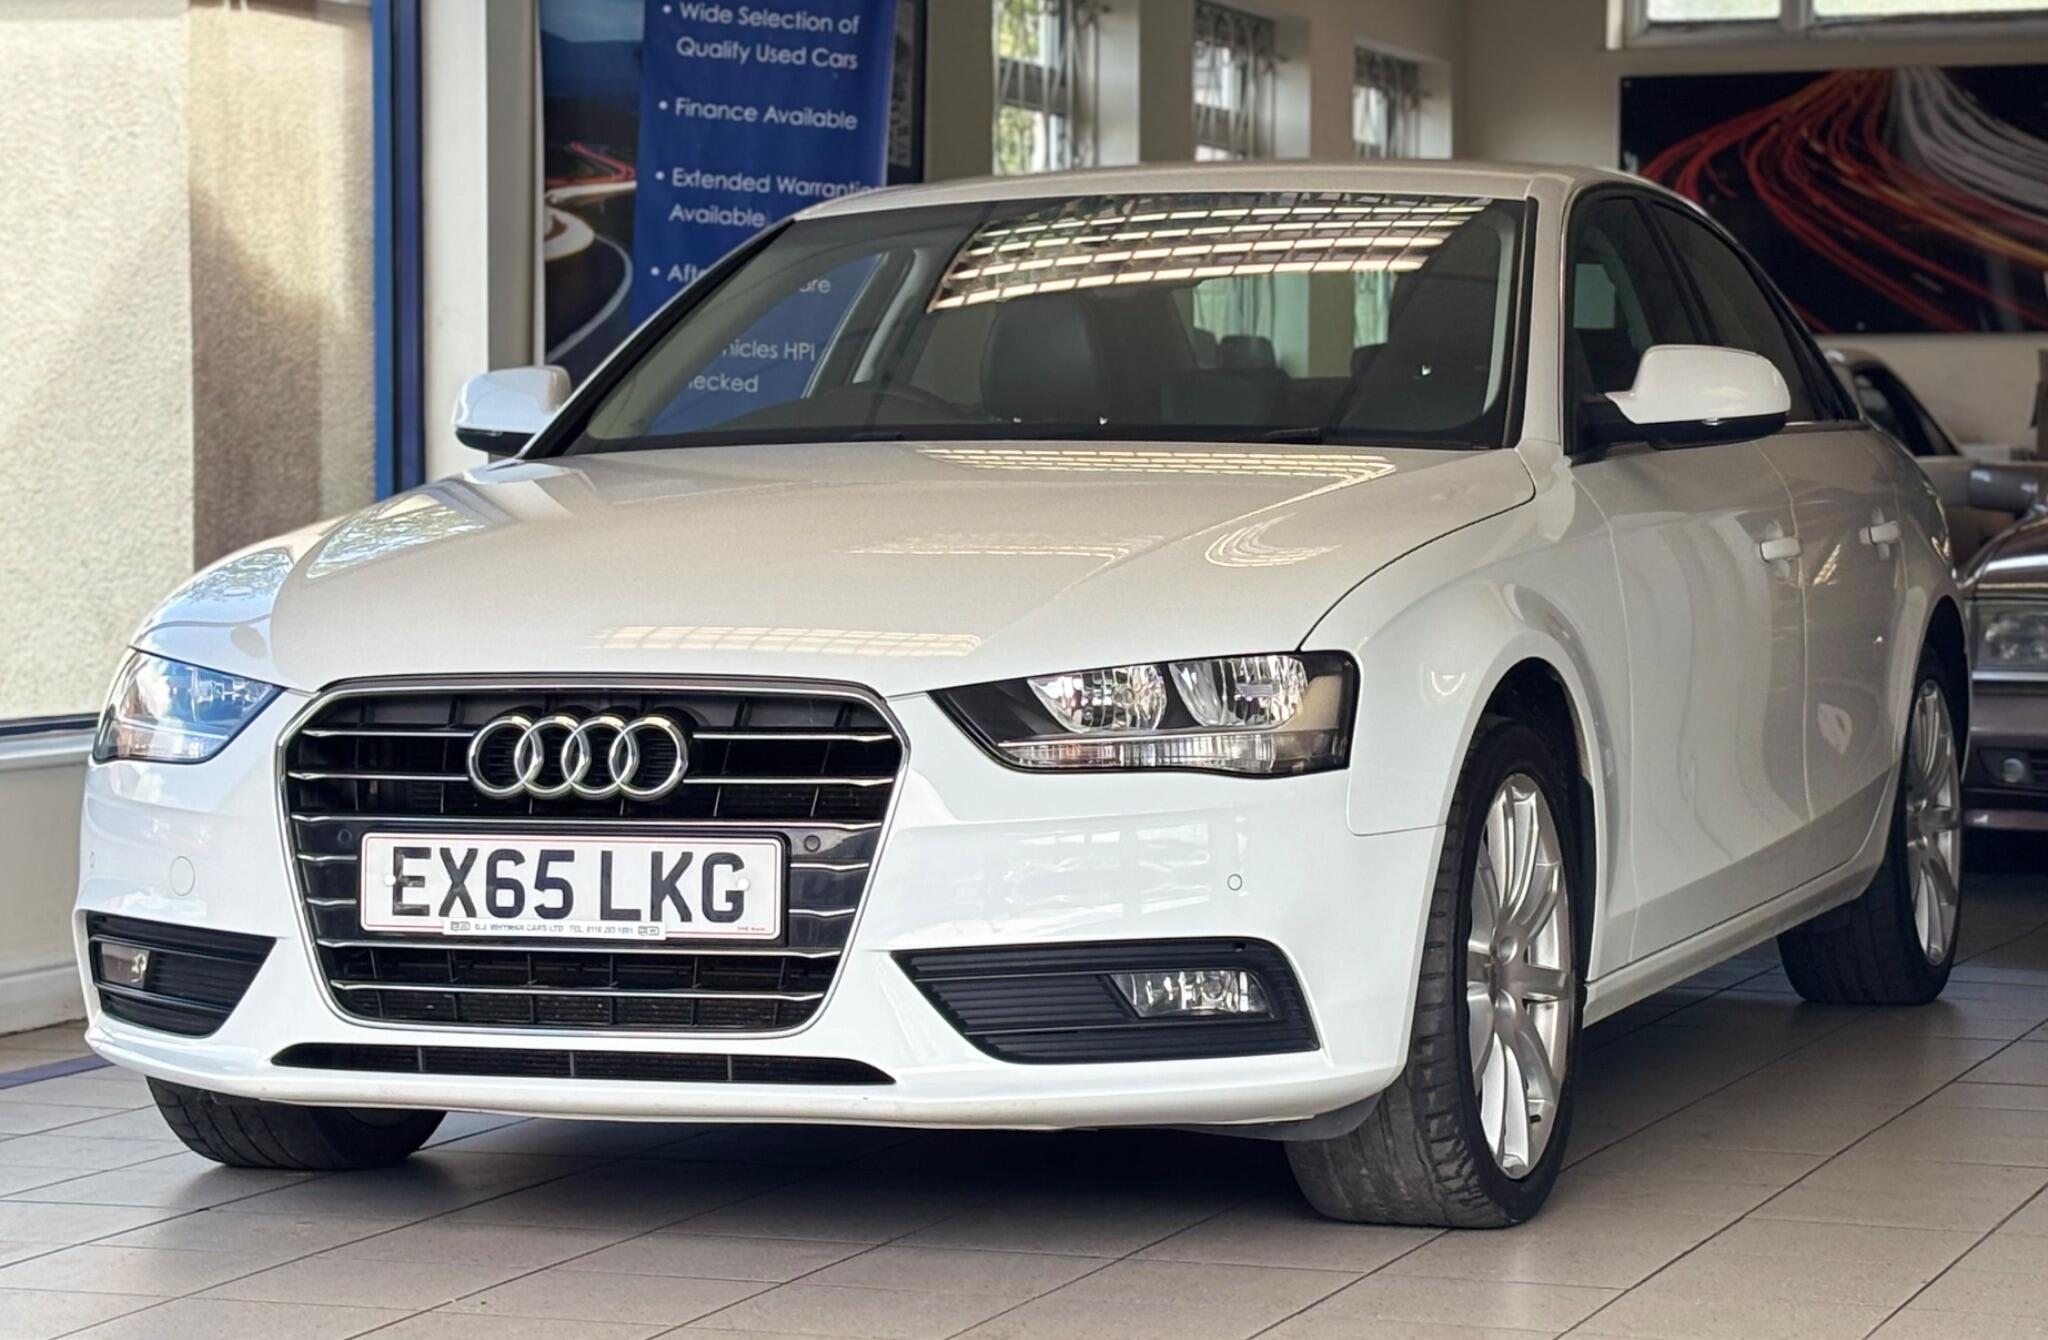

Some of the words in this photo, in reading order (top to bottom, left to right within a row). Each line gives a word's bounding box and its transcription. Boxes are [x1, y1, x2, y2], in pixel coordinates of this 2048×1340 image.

[679, 2, 733, 24] Wide
[738, 6, 833, 33] Selection
[838, 15, 861, 34] of
[676, 36, 751, 65] Quality
[756, 43, 807, 65] Used
[811, 47, 859, 70] Cars
[675, 97, 758, 122] Finance
[763, 106, 858, 131] Available
[672, 167, 770, 193] Extended
[669, 204, 766, 227] Available
[784, 342, 816, 361] HPI
[392, 847, 576, 920] EX65
[600, 850, 746, 924] LKG
